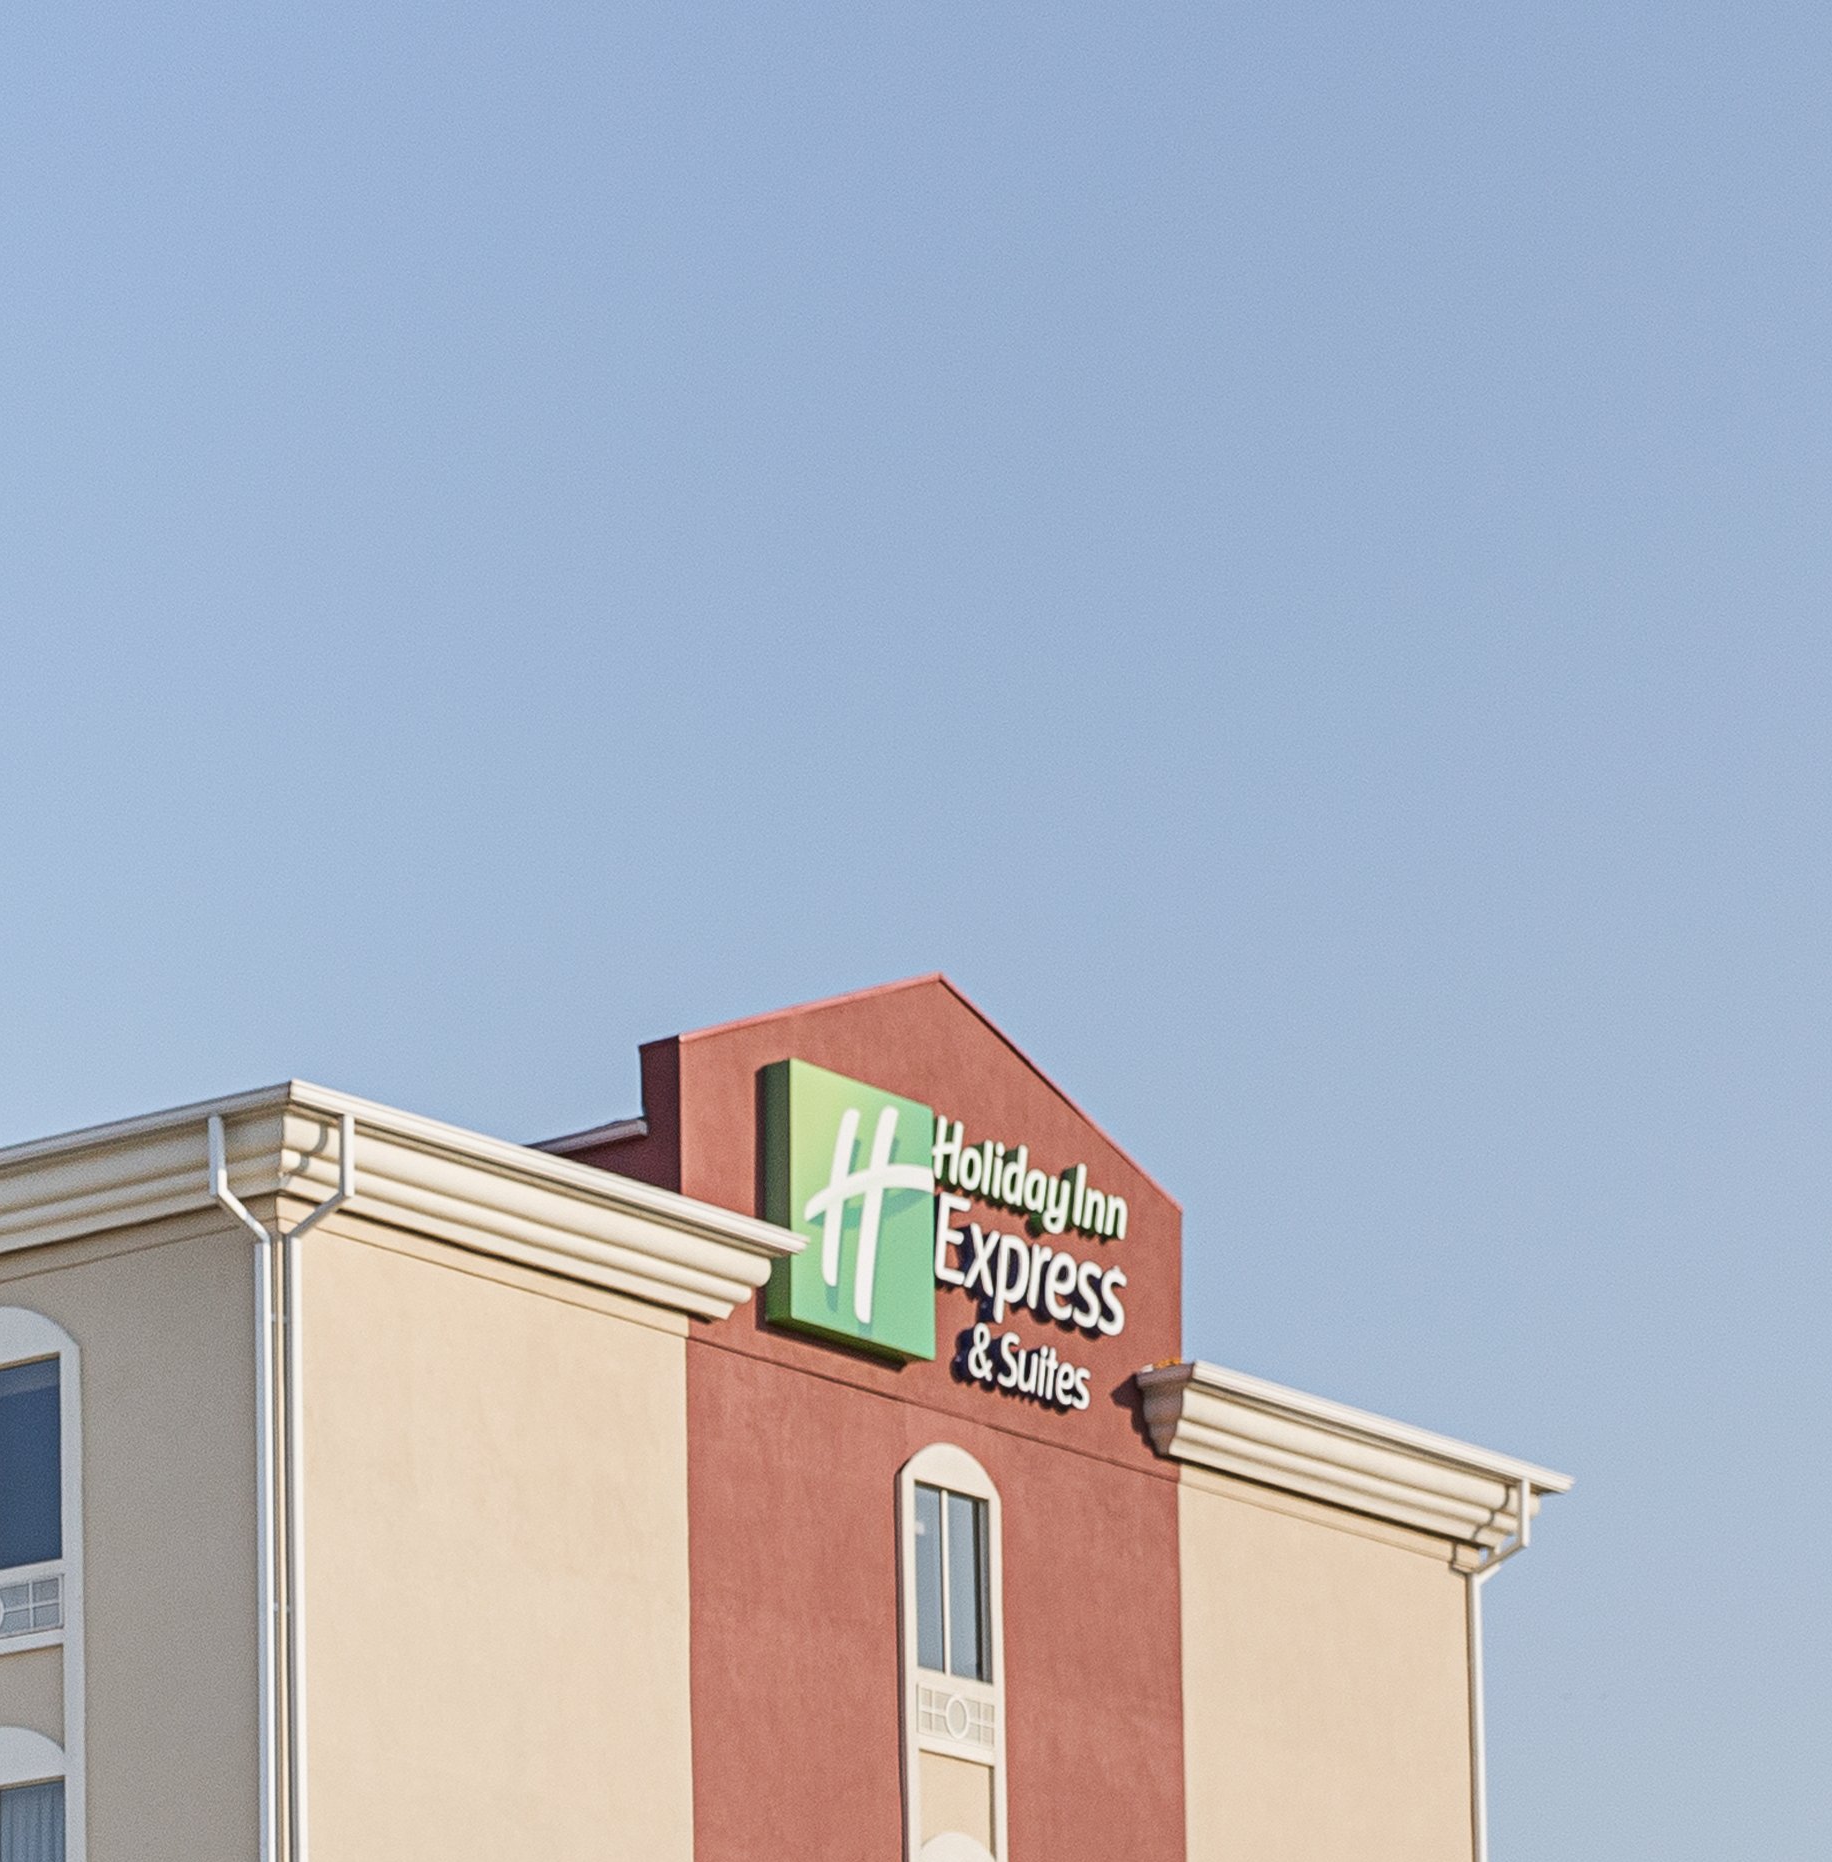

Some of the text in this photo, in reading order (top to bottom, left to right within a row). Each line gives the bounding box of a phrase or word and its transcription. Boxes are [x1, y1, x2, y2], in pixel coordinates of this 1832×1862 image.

[932, 1114, 1129, 1241] Holiday Inn
[934, 1192, 1129, 1337] Express
[966, 1322, 1091, 1411] & Suites
